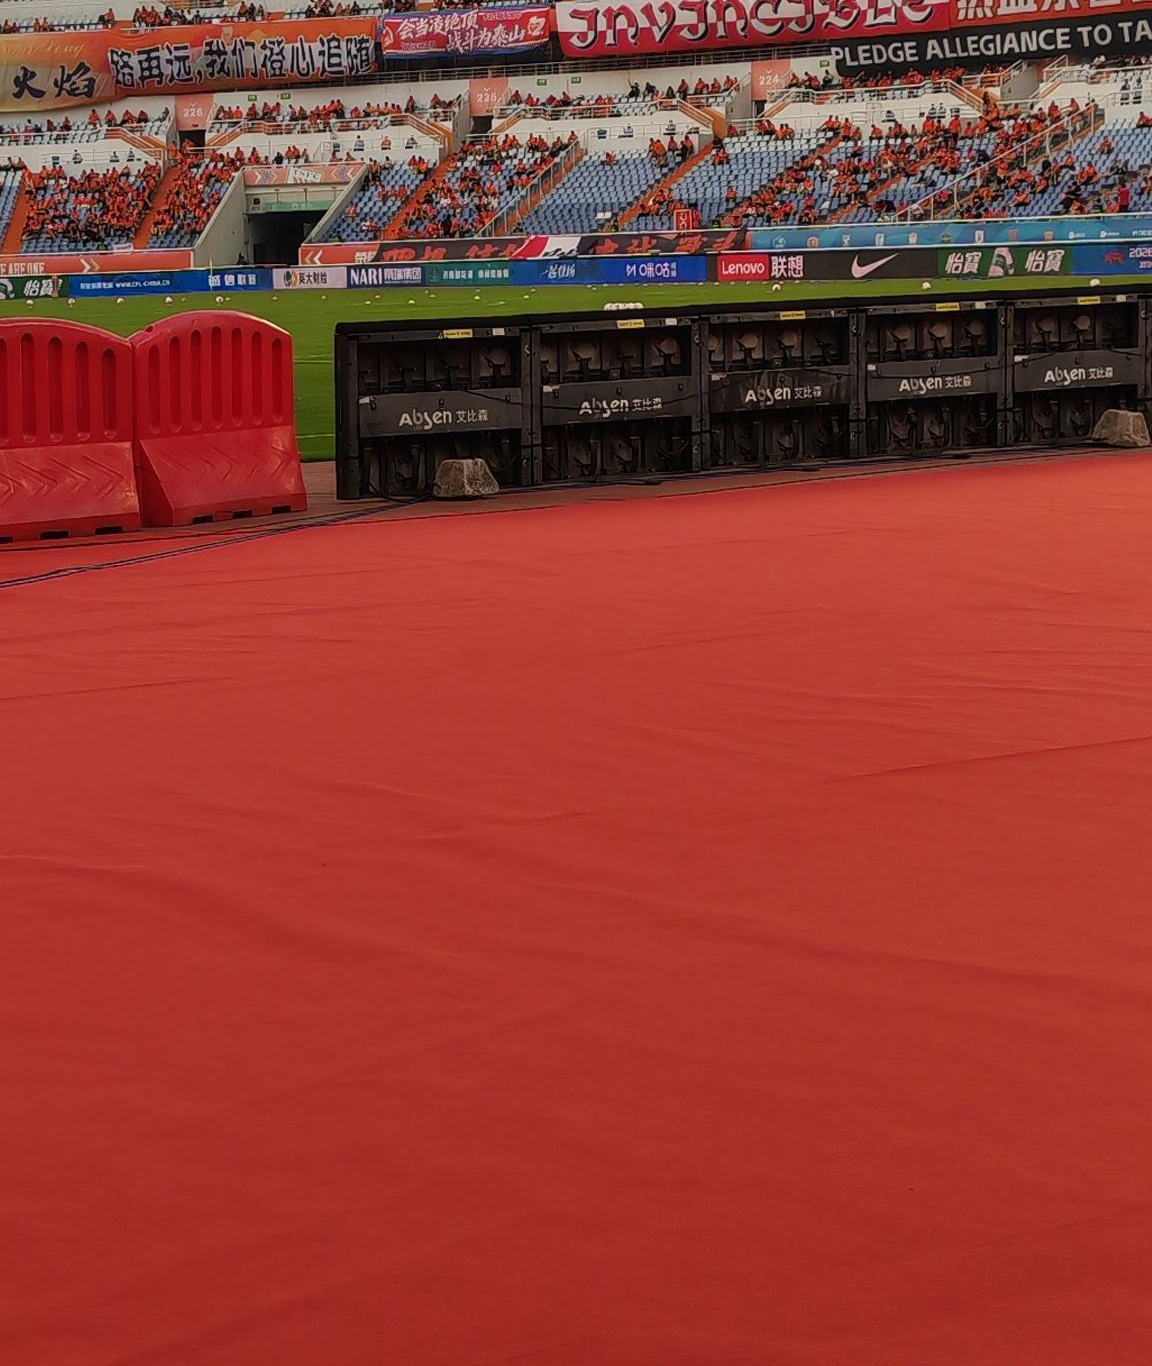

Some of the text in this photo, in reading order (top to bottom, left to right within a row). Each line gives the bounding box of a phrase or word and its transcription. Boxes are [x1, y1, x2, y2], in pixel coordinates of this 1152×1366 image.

[831, 41, 919, 66] PLEDGE
[926, 28, 1072, 61] ALLEGIANCE
[1077, 23, 1112, 48] TO
[351, 268, 382, 285] NARI
[722, 255, 804, 278] Lenovo 联想
[899, 376, 972, 395] Absen 艾比森
[1044, 367, 1113, 385] Absen 艾比森
[745, 386, 822, 406] Absen 艾比森
[579, 397, 628, 417] Absen
[399, 409, 489, 430] Absen 艾比森
